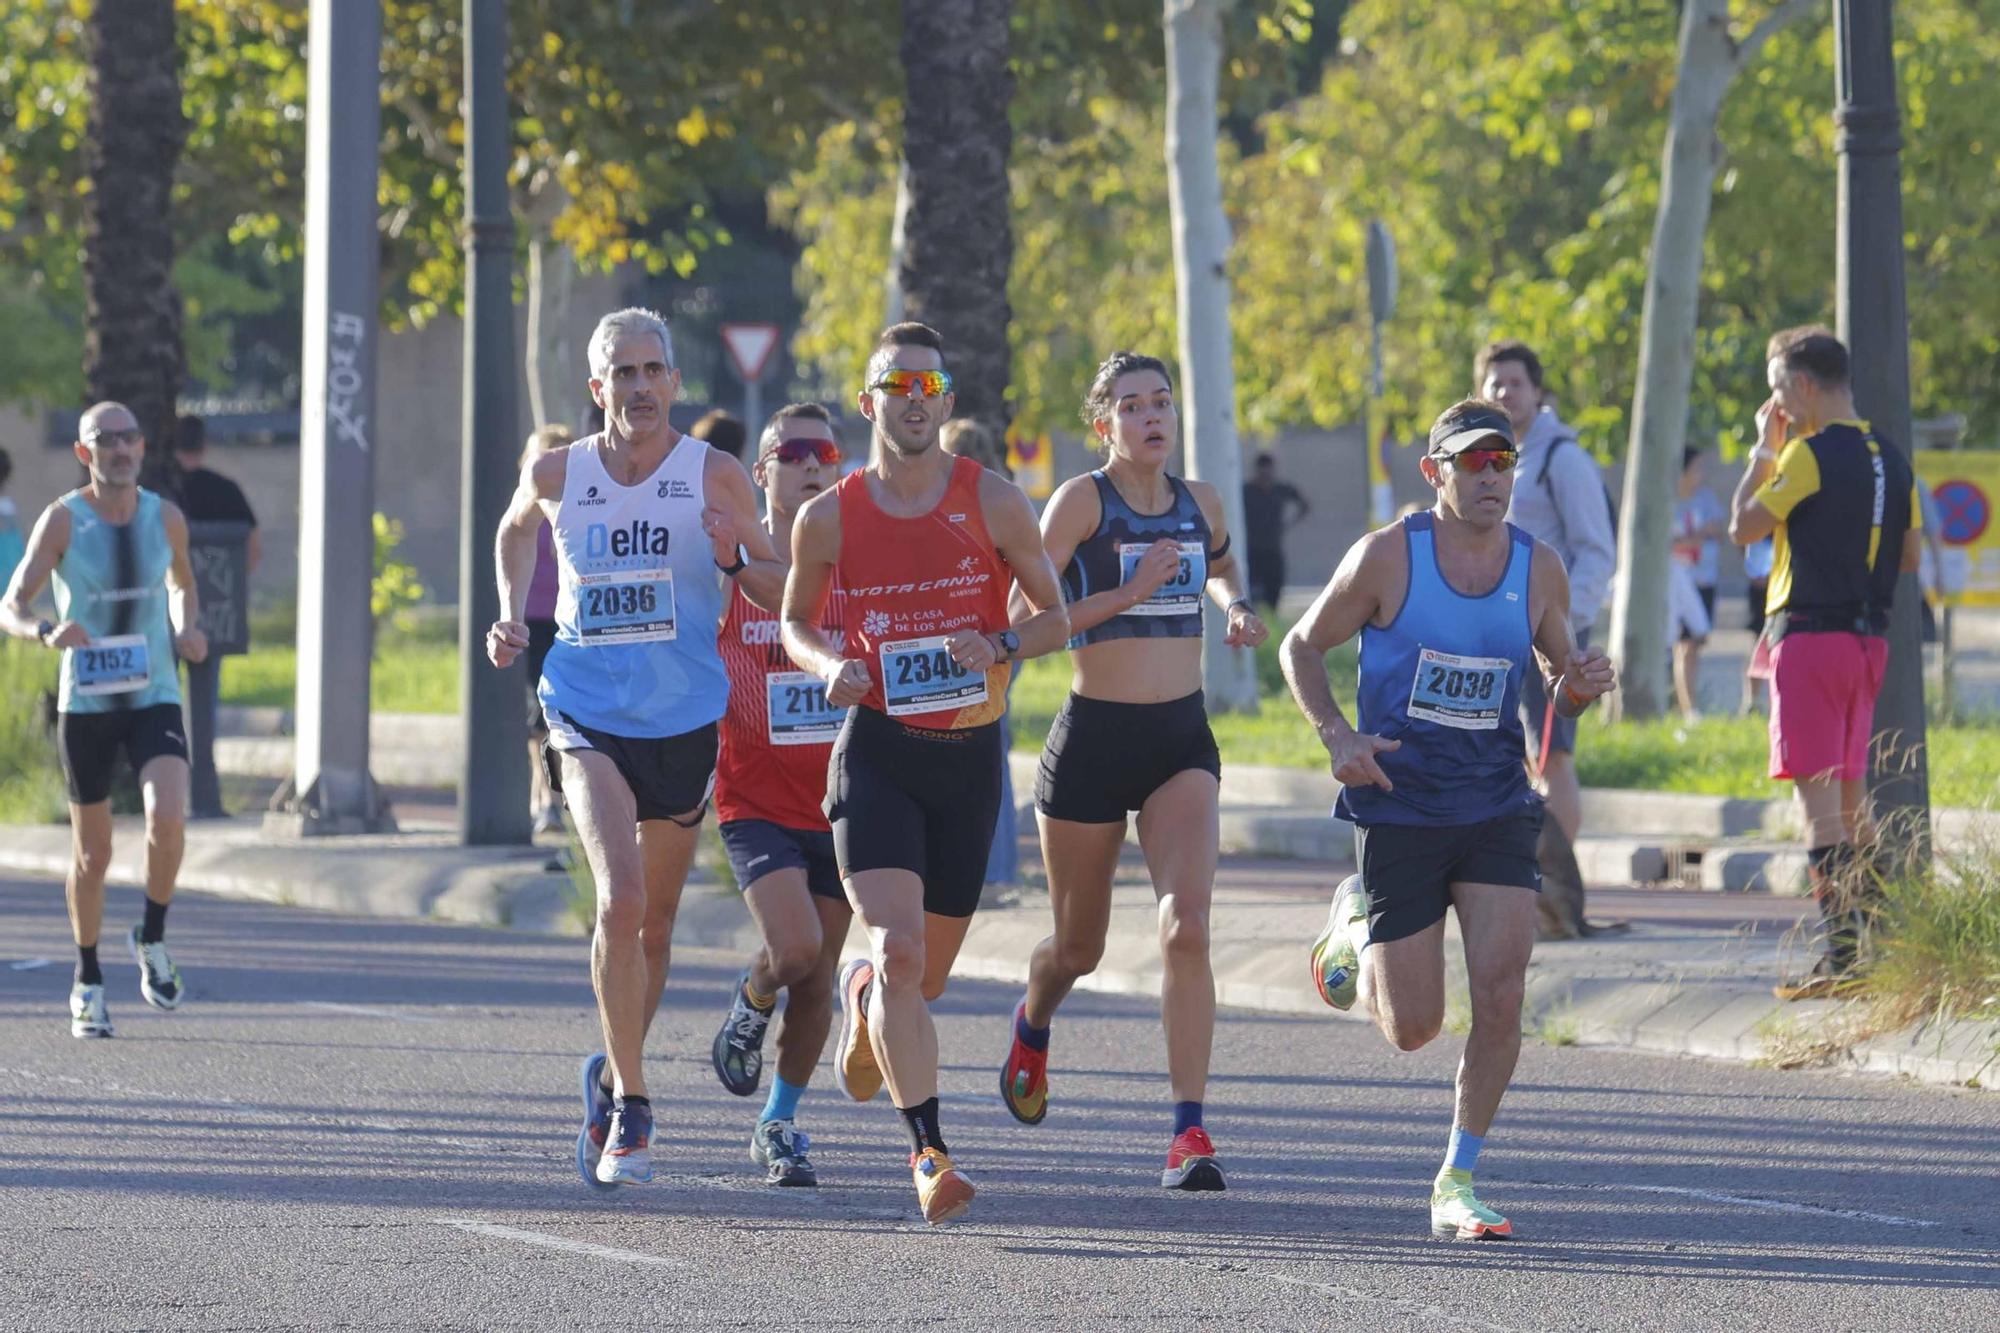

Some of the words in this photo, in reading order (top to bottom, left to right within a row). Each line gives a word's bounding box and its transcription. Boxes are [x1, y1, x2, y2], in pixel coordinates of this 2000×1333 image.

[577, 498, 607, 507] VIATOR
[586, 520, 670, 559] Delta
[918, 574, 991, 592] CANYA
[587, 584, 656, 617] 2036
[894, 613, 909, 622] LA
[913, 609, 945, 621] CASA
[895, 623, 910, 632] DE
[914, 621, 935, 632] LOS
[85, 649, 134, 672] 2152
[1427, 666, 1495, 701] 2038
